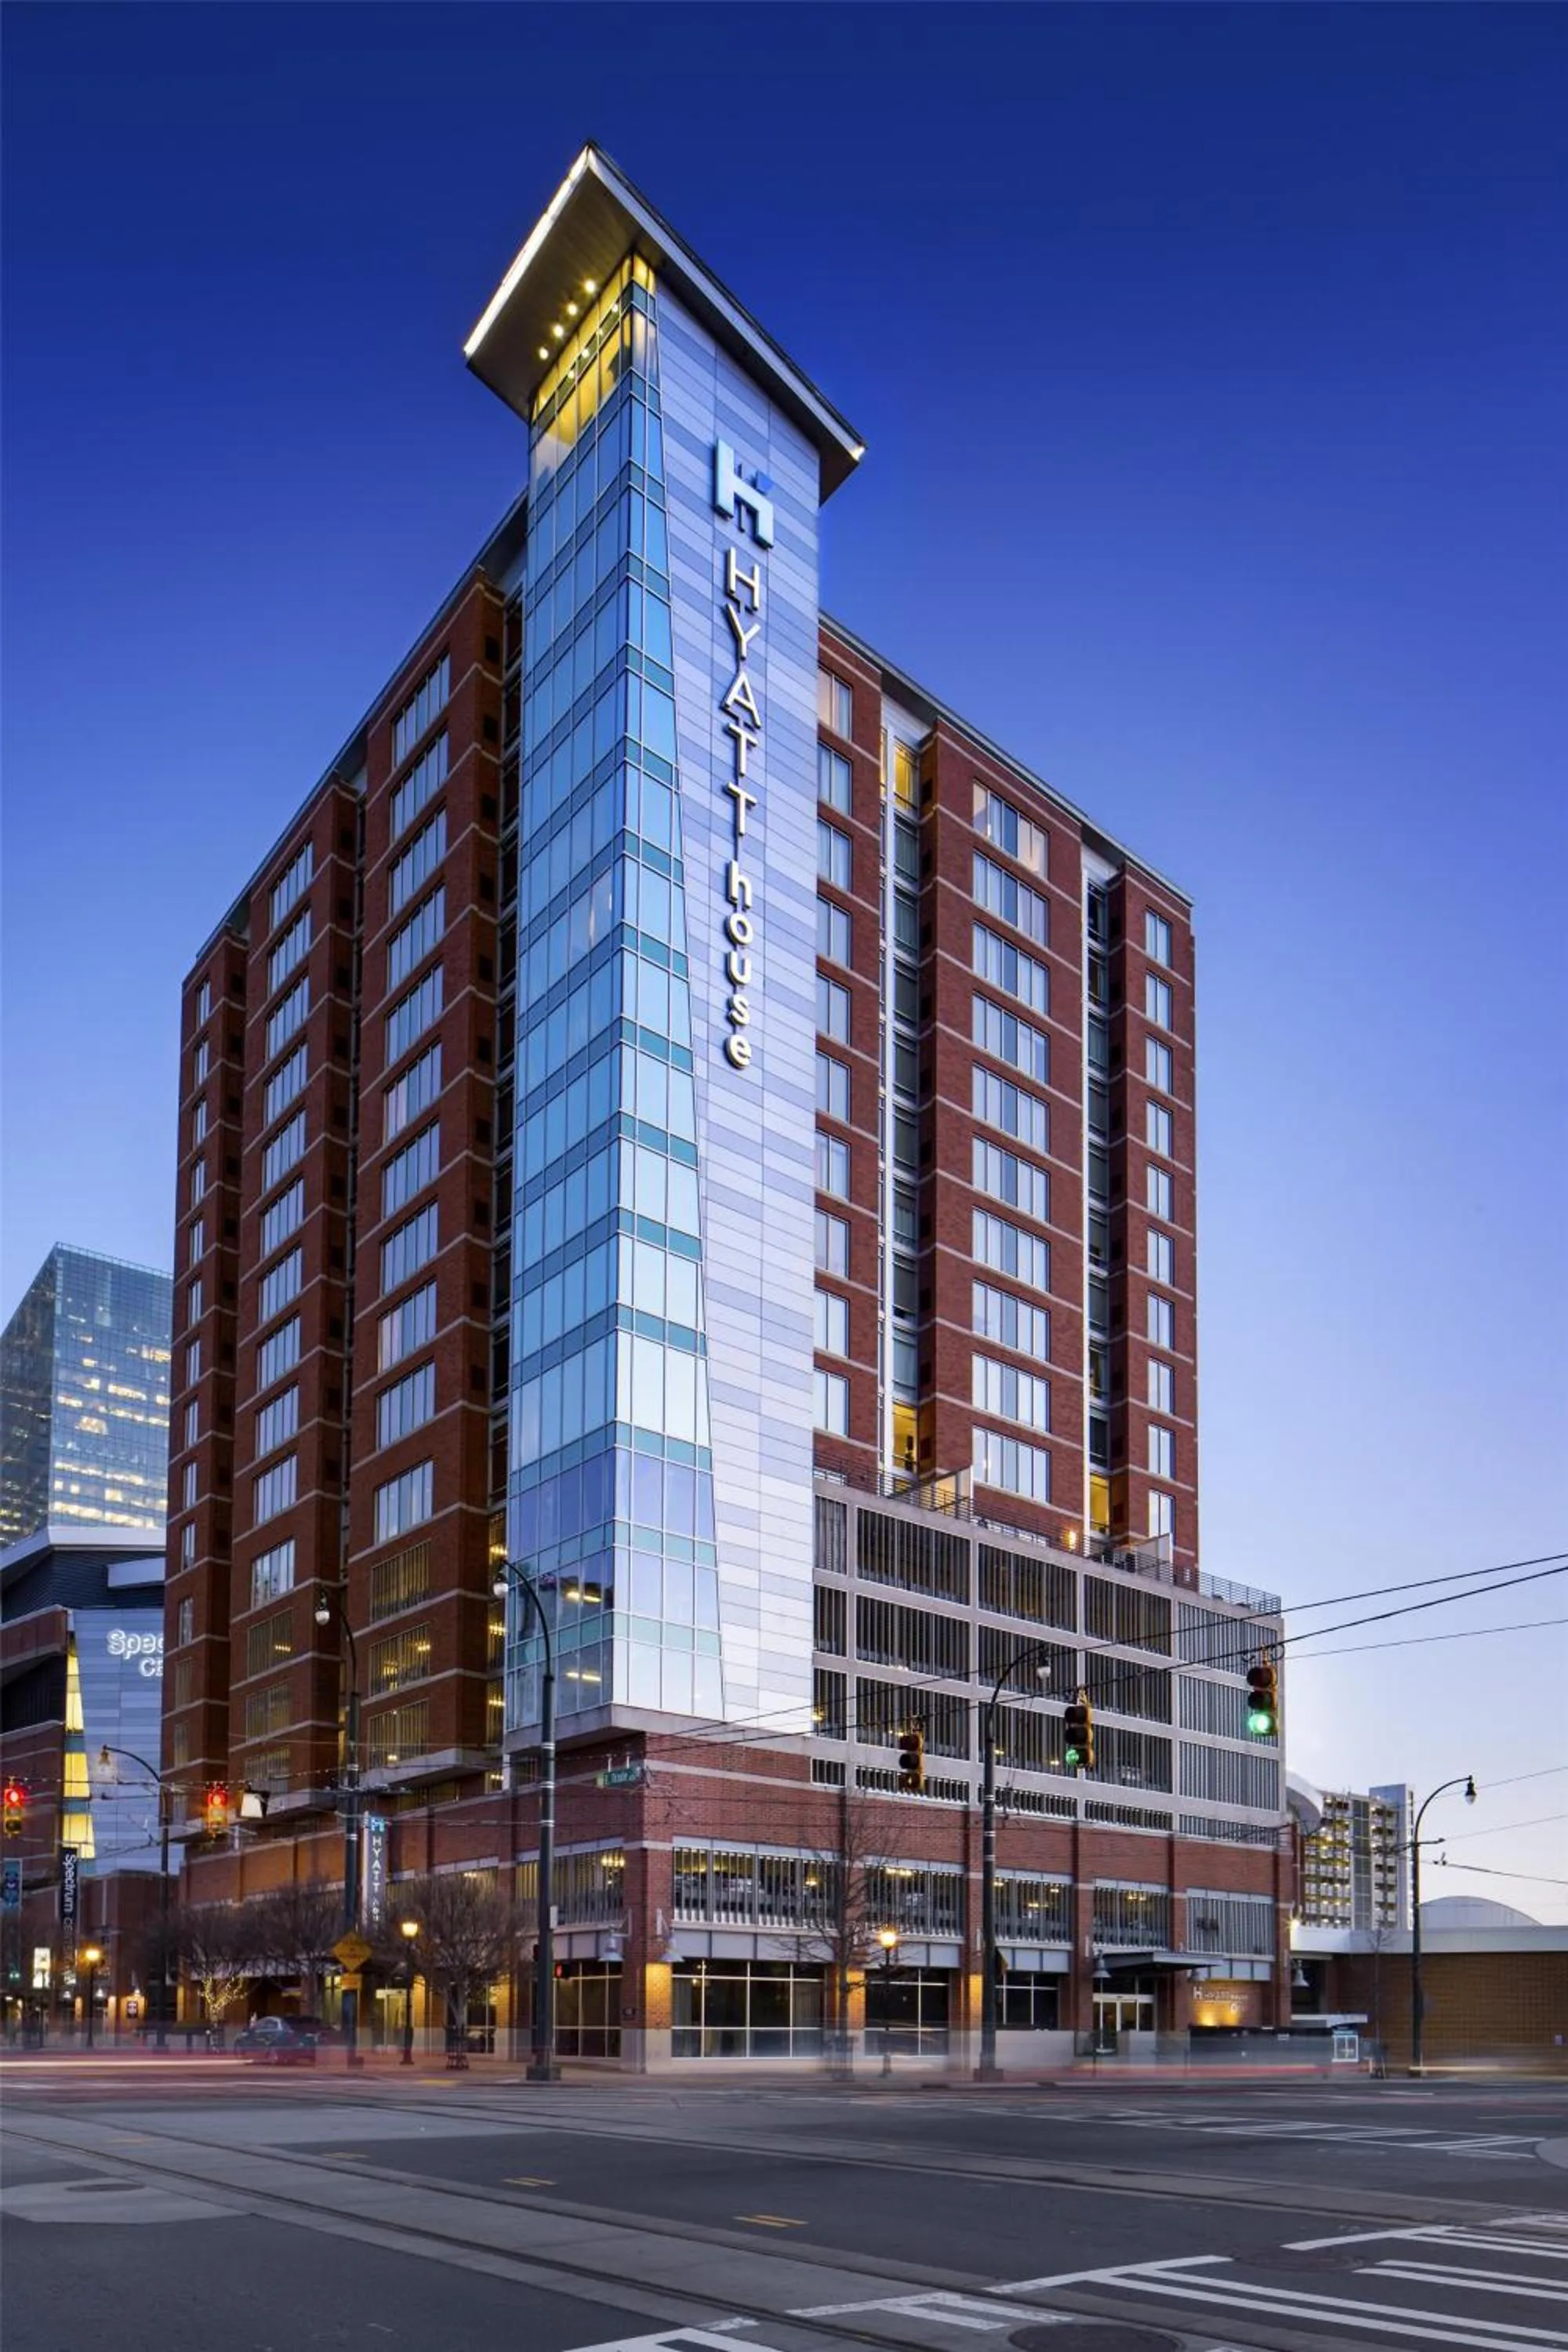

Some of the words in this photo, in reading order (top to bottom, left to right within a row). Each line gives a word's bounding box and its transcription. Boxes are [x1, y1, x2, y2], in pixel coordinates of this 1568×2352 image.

[723, 546, 762, 837] HYATT
[726, 859, 754, 1069] house
[63, 1853, 77, 1913] Spectrum
[372, 1835, 382, 1893] HYATT
